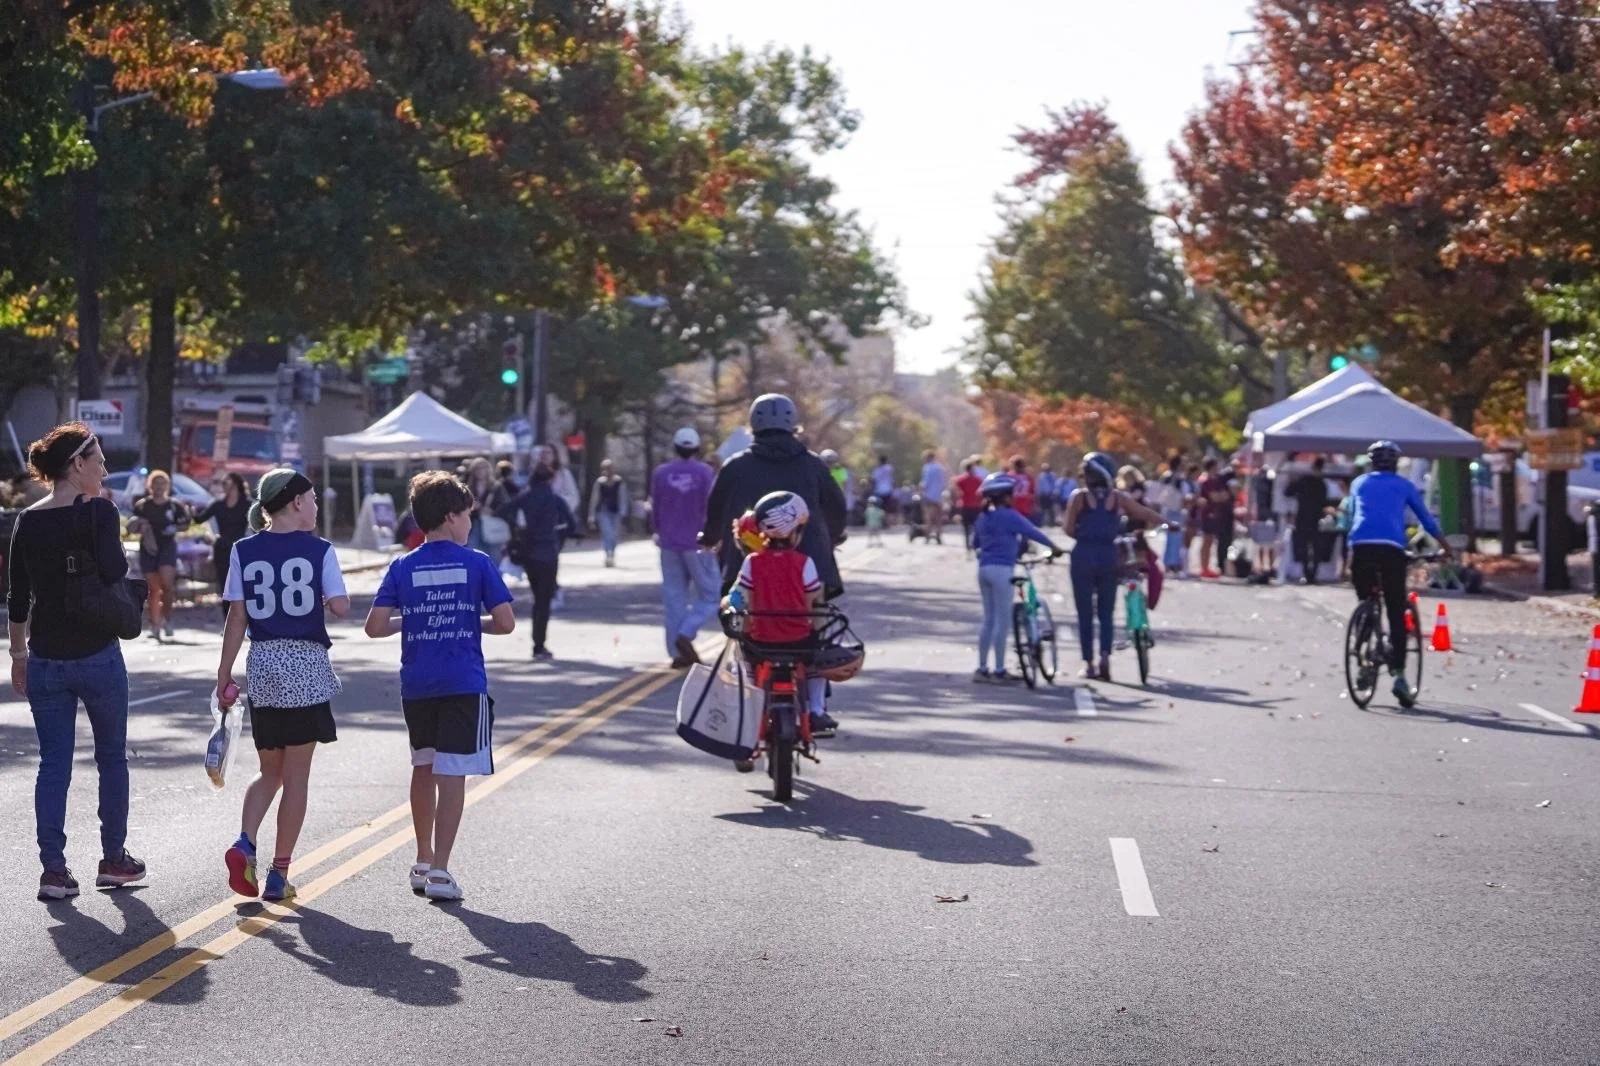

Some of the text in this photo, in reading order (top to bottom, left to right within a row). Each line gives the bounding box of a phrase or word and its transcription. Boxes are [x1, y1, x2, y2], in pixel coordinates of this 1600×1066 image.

[243, 557, 315, 619] 38
[425, 590, 455, 601] Talent
[402, 605, 411, 615] is
[413, 603, 435, 613] what
[437, 603, 455, 614] you
[428, 615, 455, 628] Effort
[407, 632, 414, 641] is
[415, 630, 438, 641] what
[438, 631, 454, 641] you
